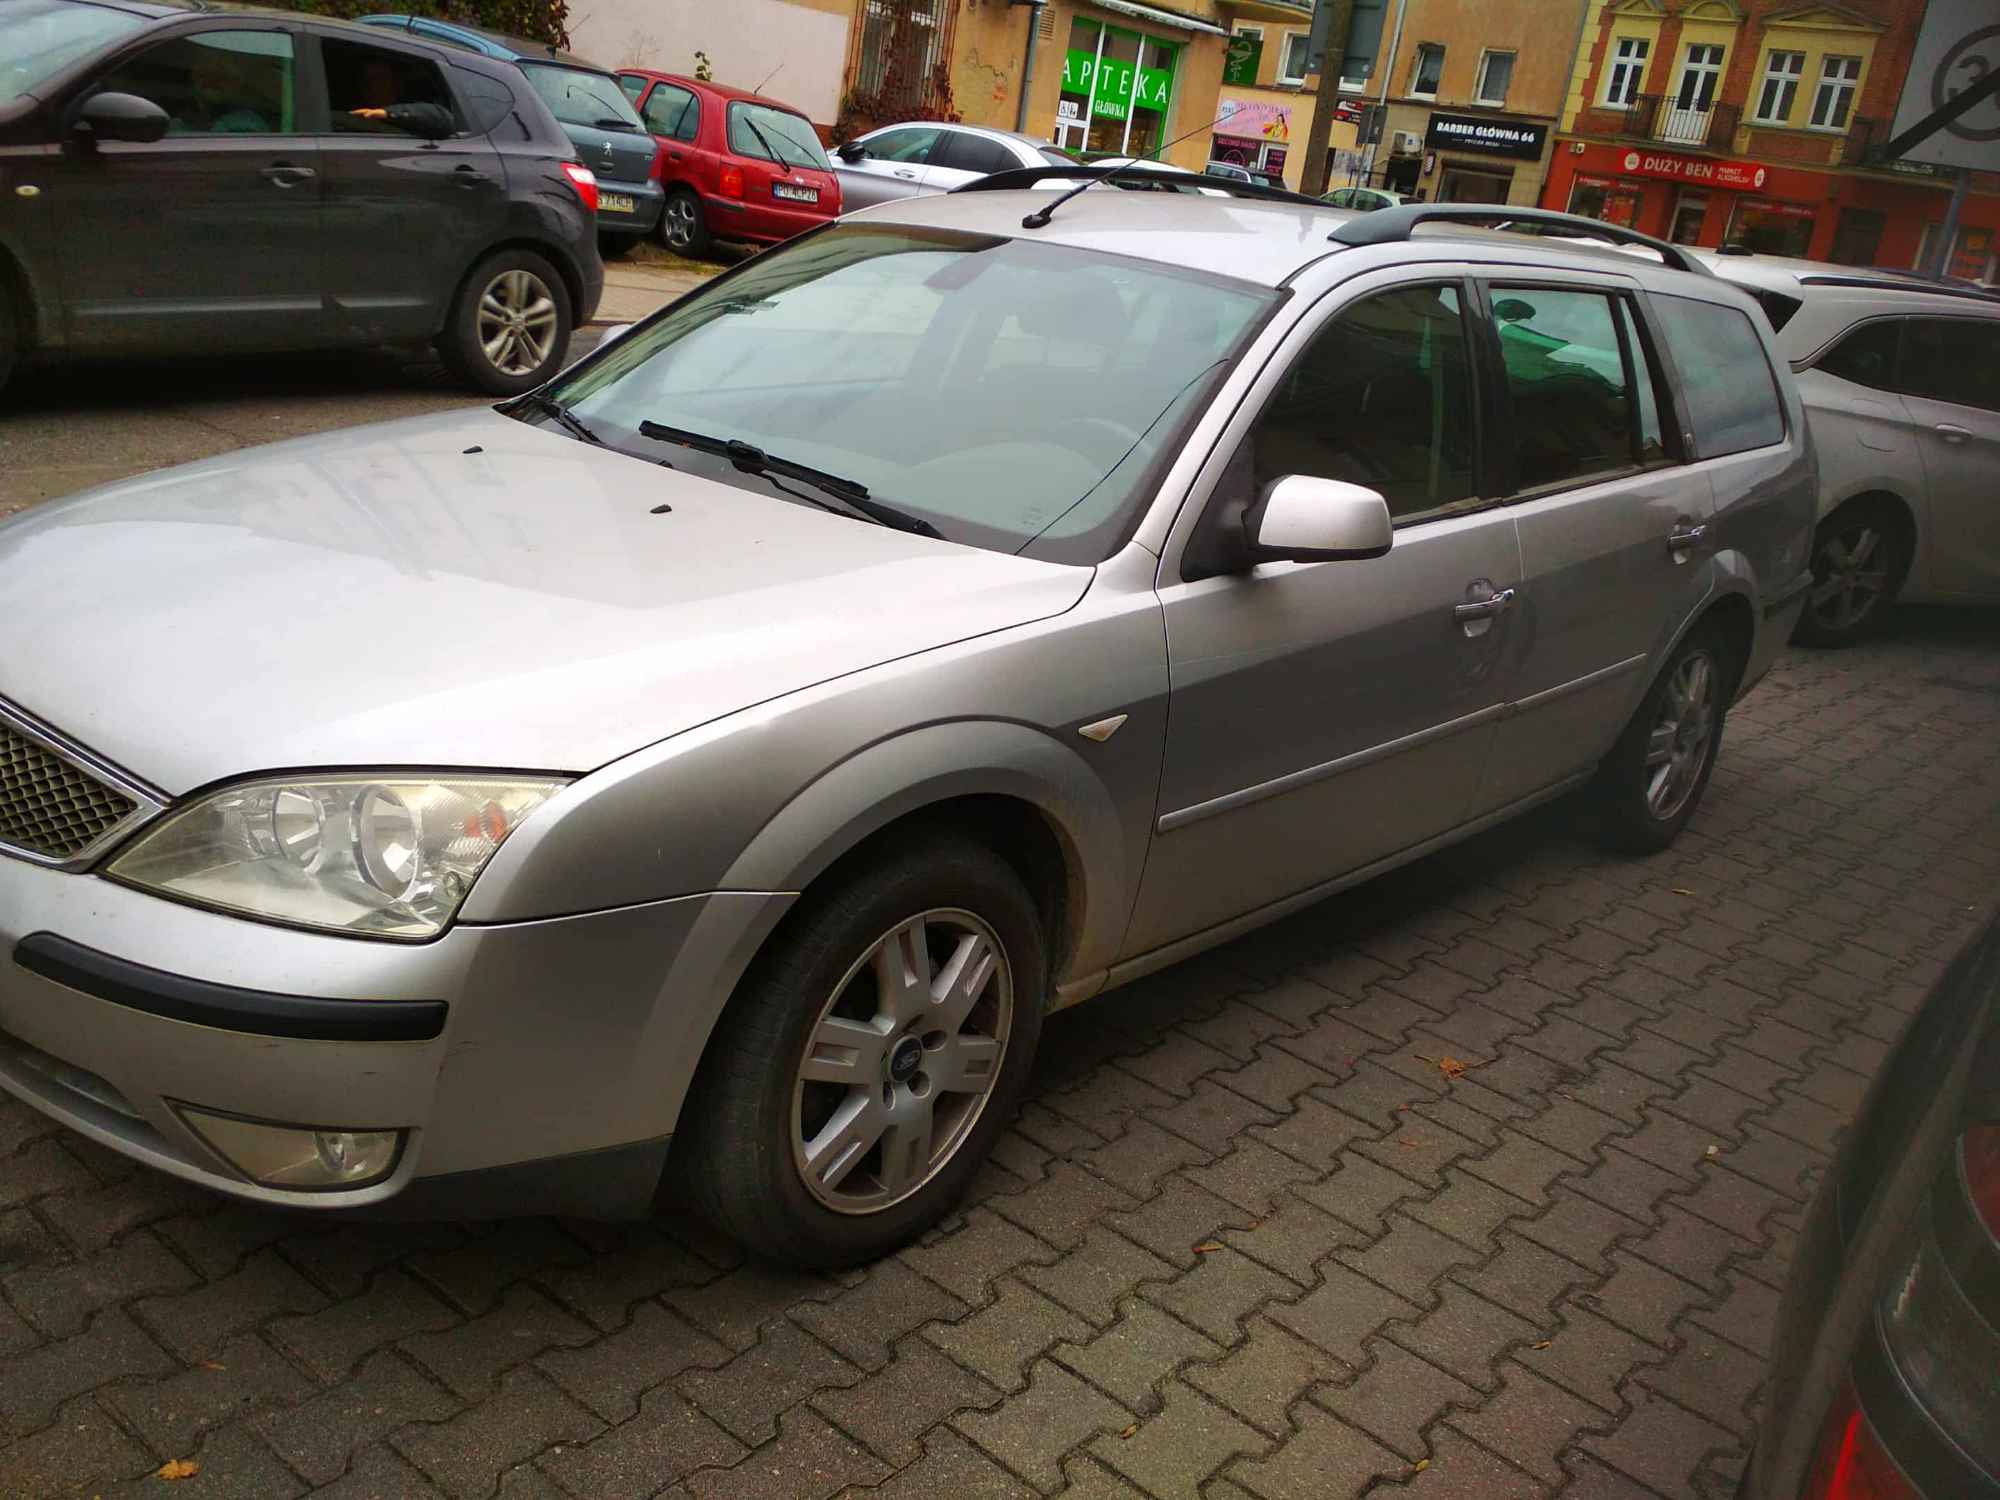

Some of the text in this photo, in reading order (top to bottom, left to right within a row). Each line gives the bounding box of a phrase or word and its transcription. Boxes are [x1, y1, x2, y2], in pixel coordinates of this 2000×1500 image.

[1063, 58, 1167, 104] APTEKA
[1095, 99, 1125, 118] GŁÓWNA
[1436, 122, 1535, 143] BARBER GŁÓWNA 66
[1644, 157, 1713, 179] DUŻY BEN
